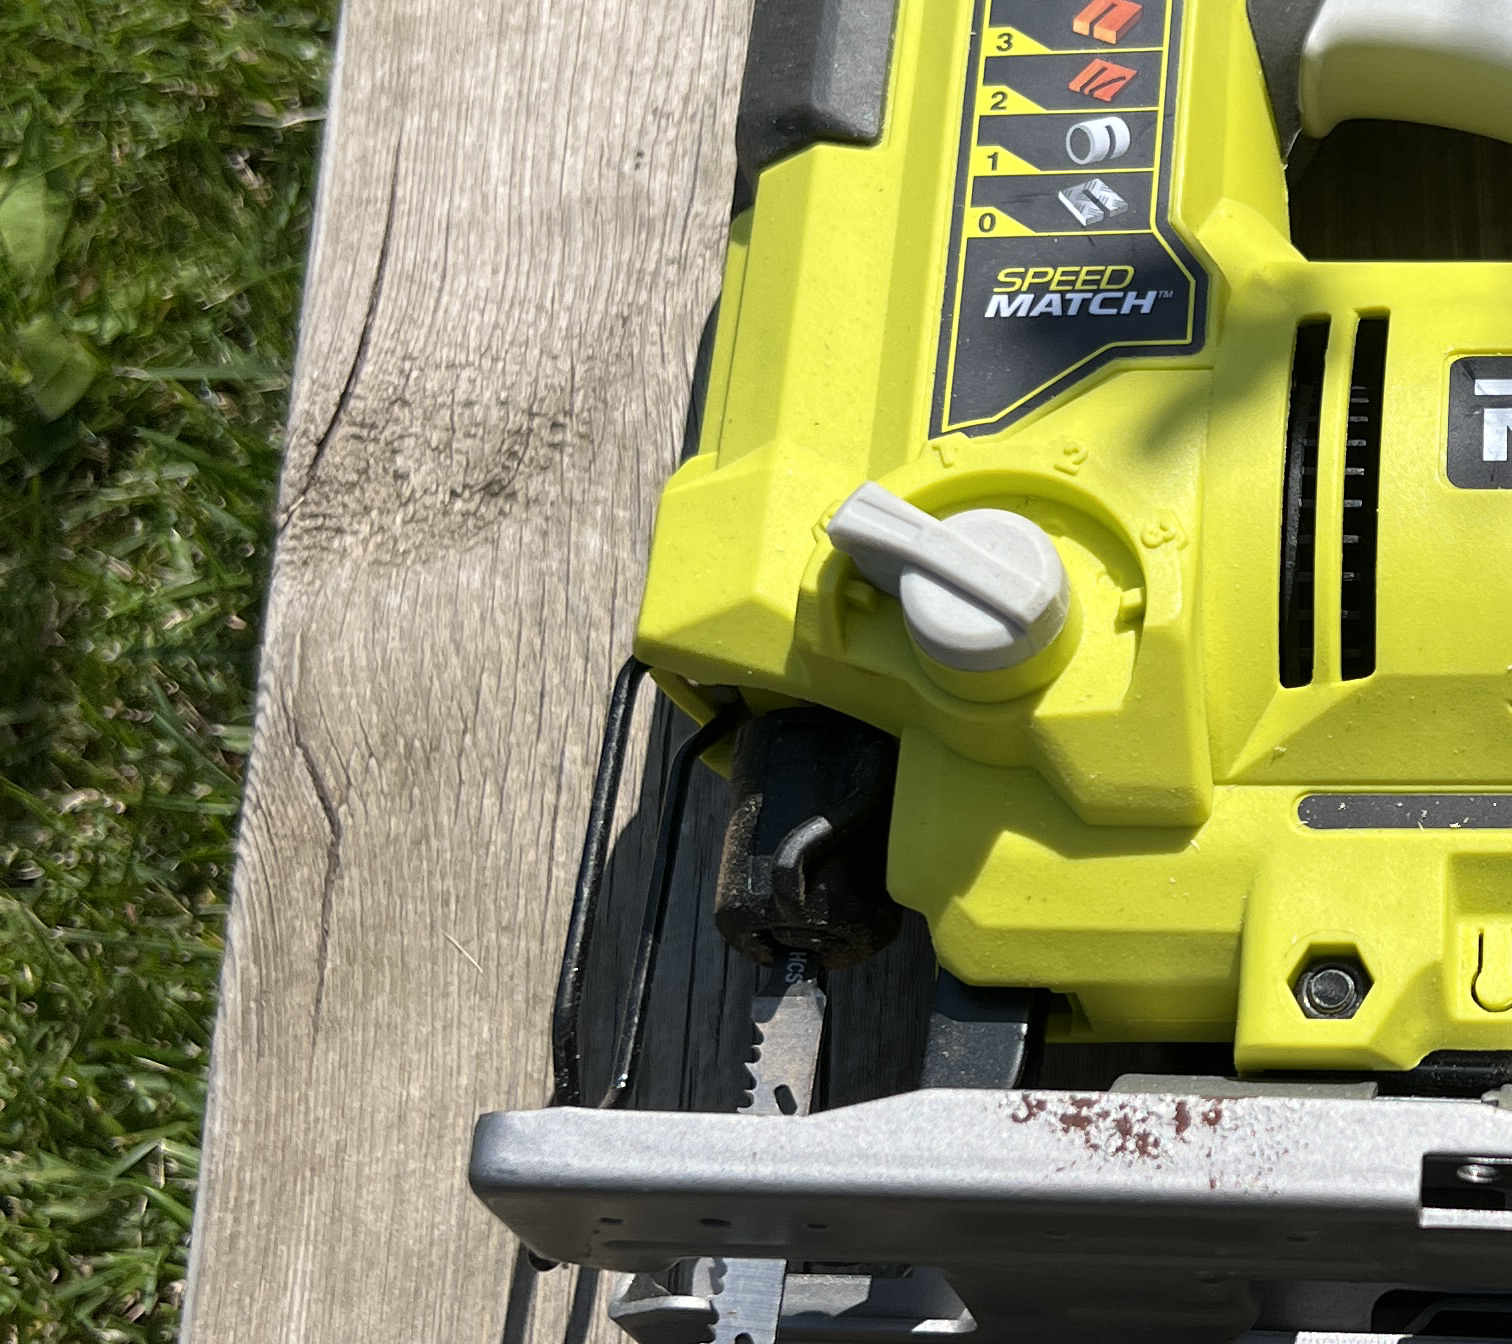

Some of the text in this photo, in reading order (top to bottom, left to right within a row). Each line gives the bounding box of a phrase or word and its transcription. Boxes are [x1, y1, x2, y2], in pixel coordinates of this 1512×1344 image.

[995, 32, 1014, 52] 3
[989, 91, 1008, 111] 2
[986, 151, 1000, 172] 1
[978, 212, 997, 233] 0
[992, 264, 1135, 293] SPEED
[1053, 441, 1090, 477] 2
[1140, 519, 1177, 550] 3
[784, 951, 808, 984] HCS
